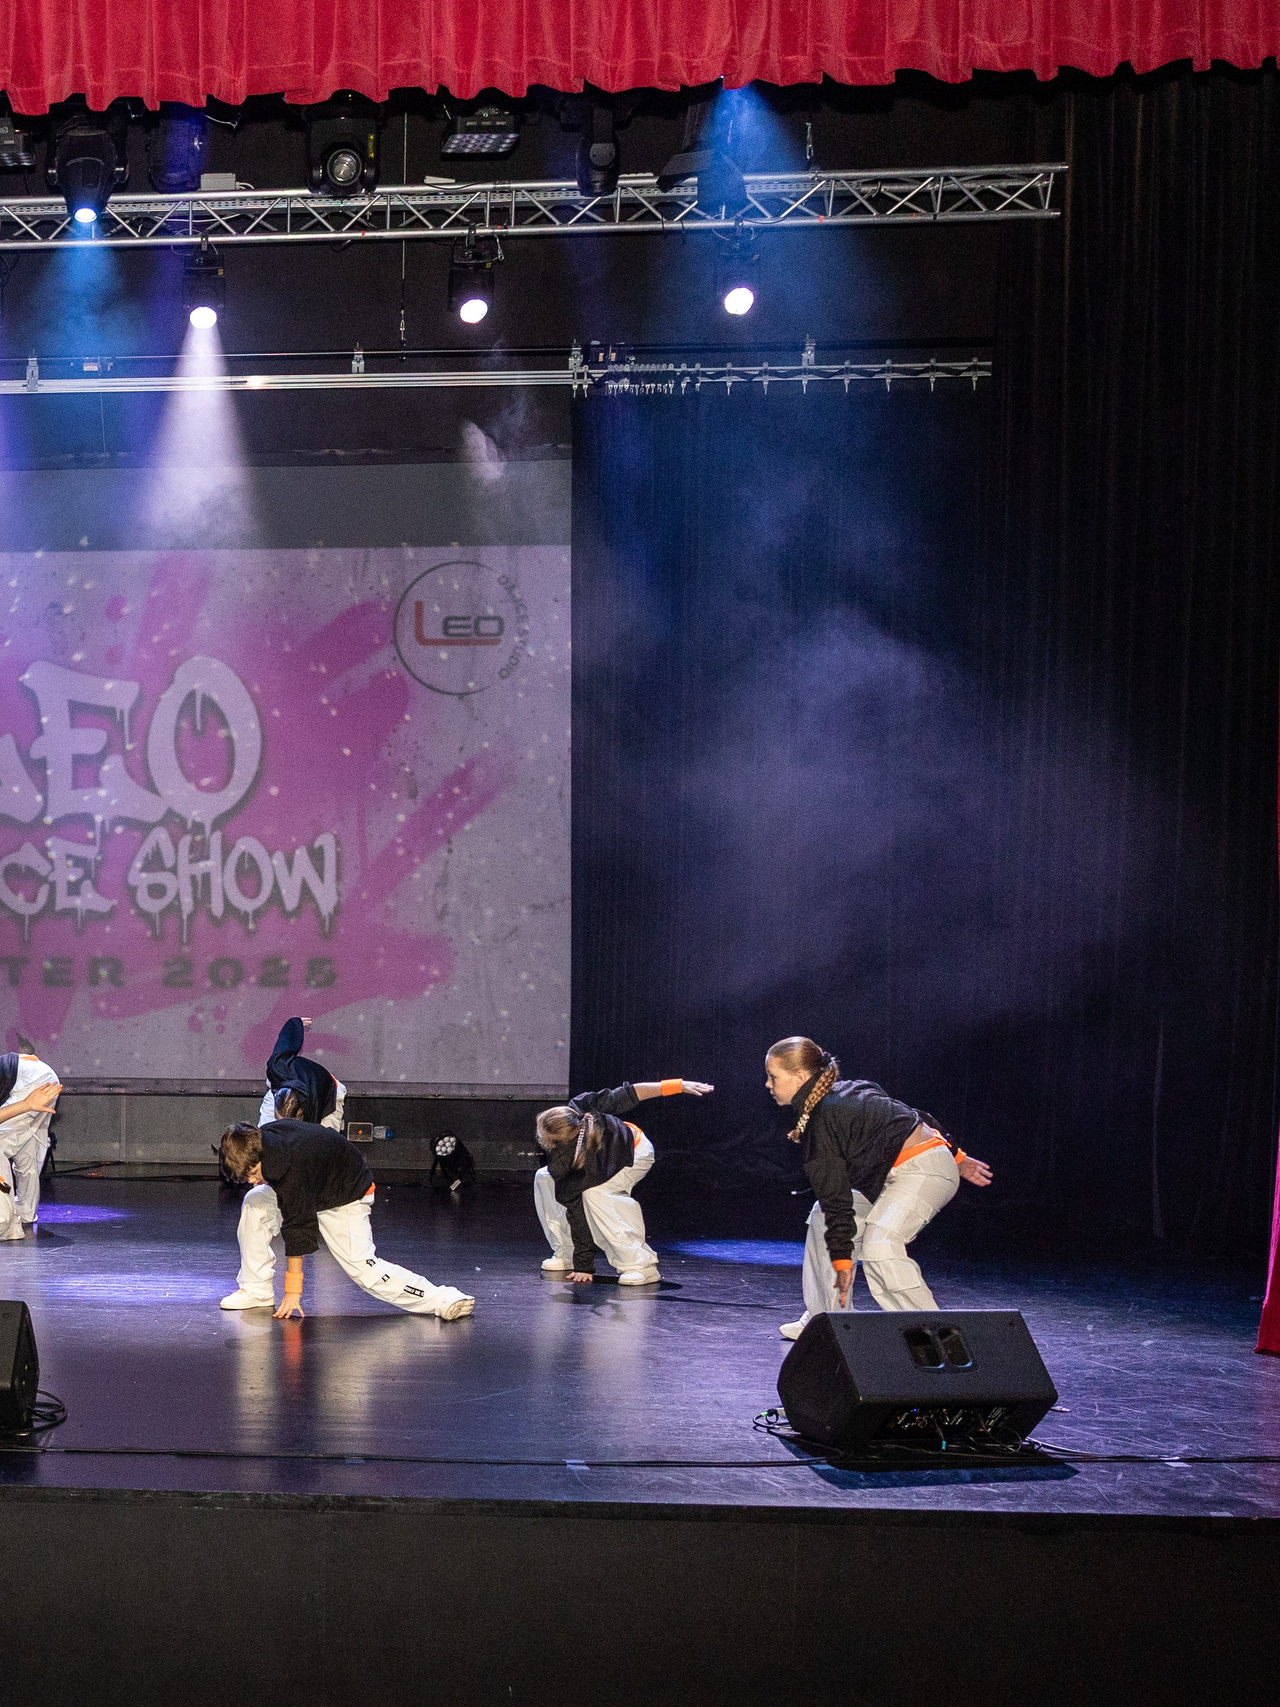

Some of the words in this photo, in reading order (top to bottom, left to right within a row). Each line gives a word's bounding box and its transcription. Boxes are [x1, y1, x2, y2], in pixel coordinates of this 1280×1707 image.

[414, 600, 505, 646] LEO
[128, 826, 340, 933] SHOW
[162, 955, 338, 988] 2025
